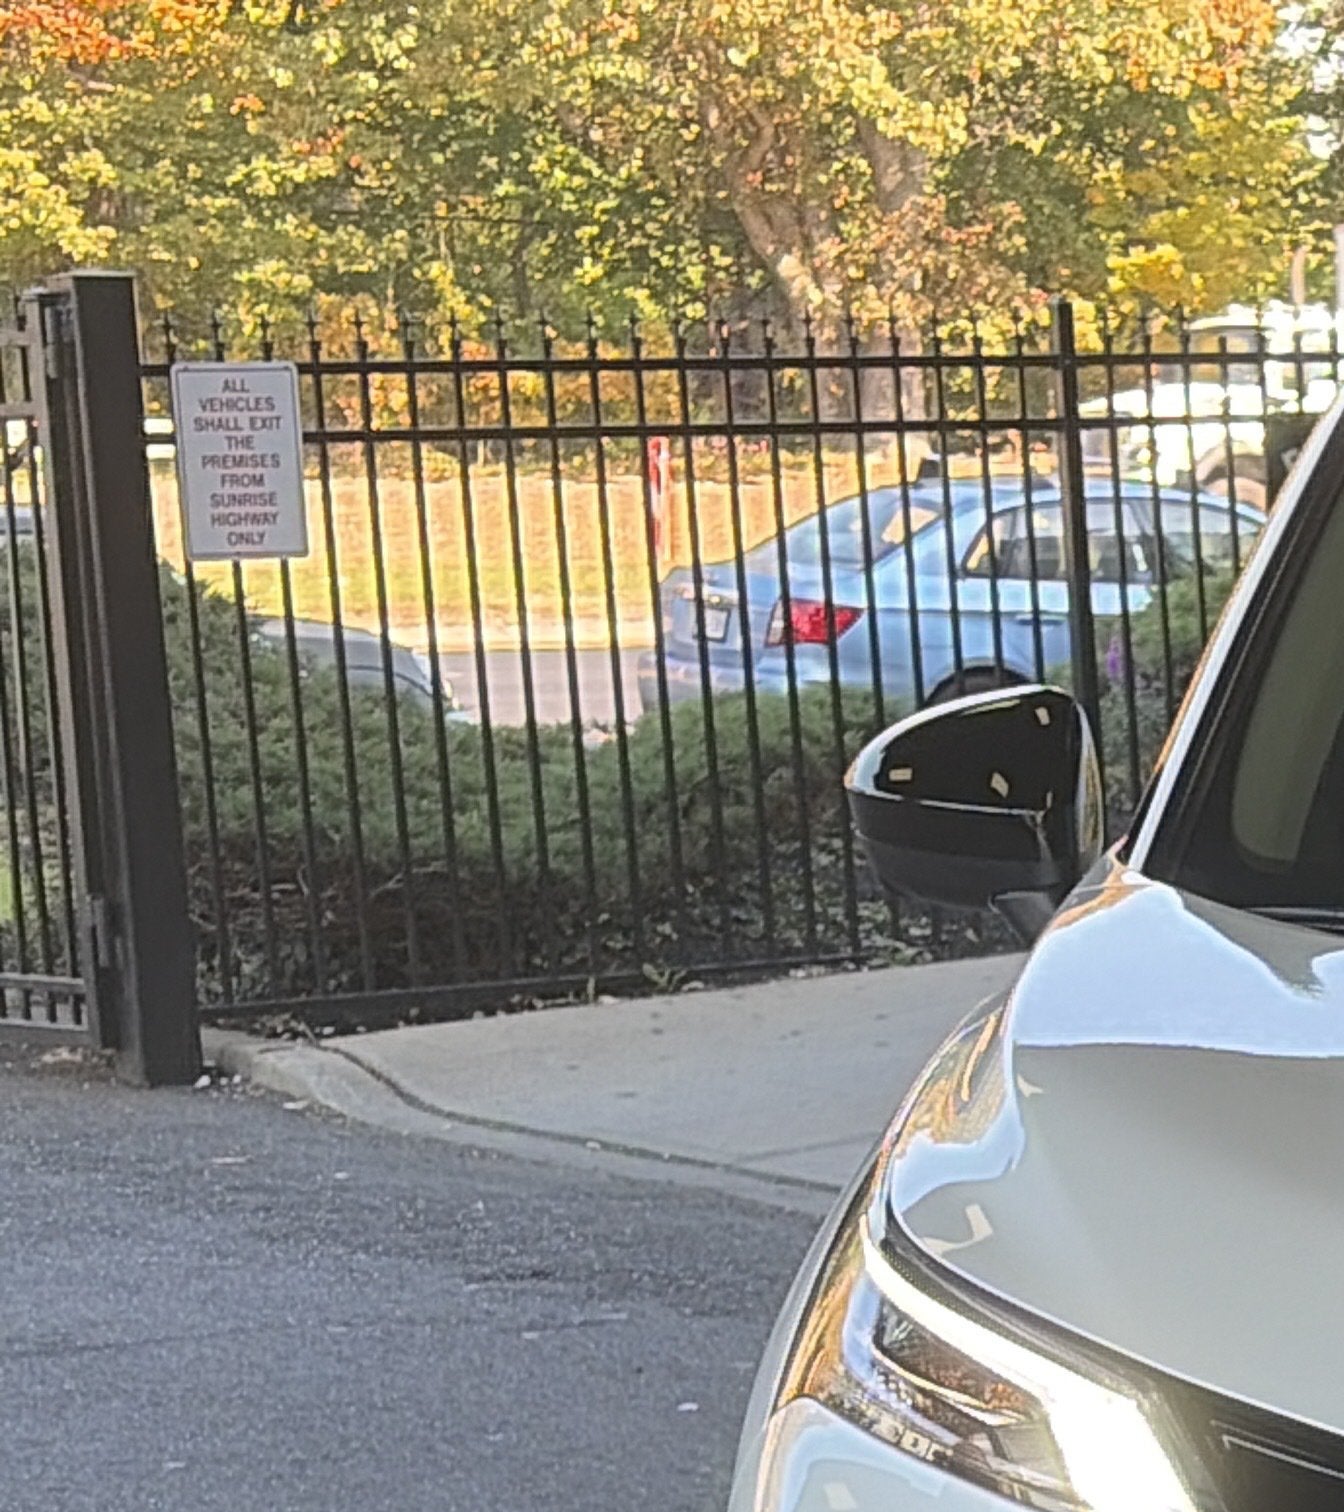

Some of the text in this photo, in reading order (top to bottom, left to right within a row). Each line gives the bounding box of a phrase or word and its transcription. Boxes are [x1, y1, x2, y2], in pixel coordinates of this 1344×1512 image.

[222, 378, 249, 392] ALL
[199, 397, 275, 412] VEHICLES
[193, 416, 281, 432] SHALL EXIT
[224, 435, 254, 450] THE
[201, 454, 280, 470] PREMISES
[220, 473, 265, 488] FROM
[210, 492, 278, 508] SUNRISE
[211, 512, 279, 527] HIGHWAY
[227, 531, 266, 546] ONLY
